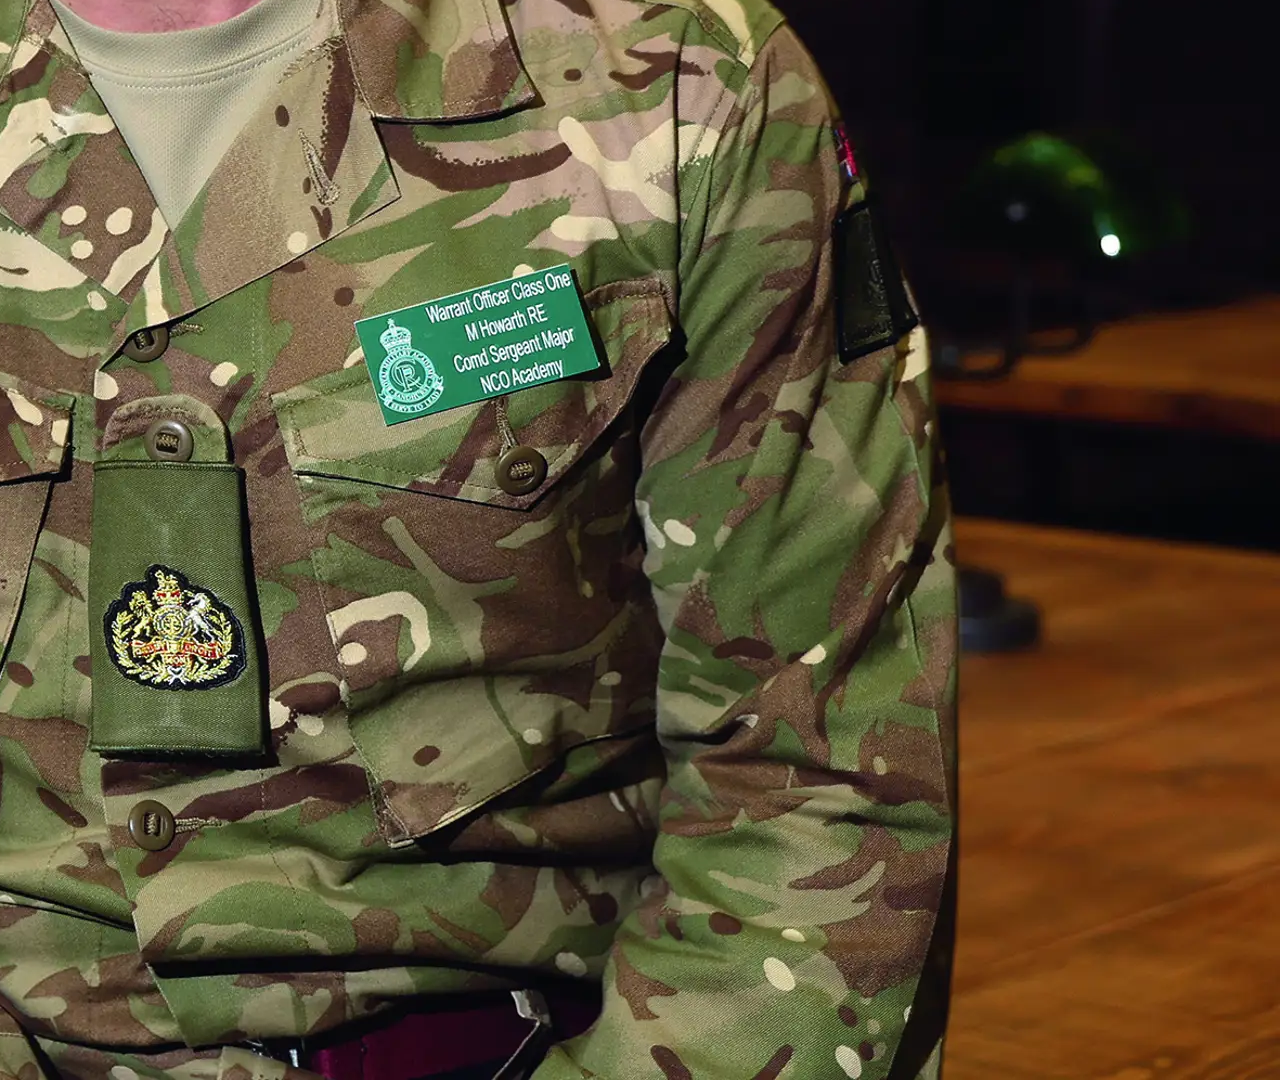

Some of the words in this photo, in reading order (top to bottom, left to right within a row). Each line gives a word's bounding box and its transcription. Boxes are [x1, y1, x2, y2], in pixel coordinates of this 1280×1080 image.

[425, 296, 473, 324] Warrant
[473, 289, 510, 311] Officer
[511, 280, 545, 300] Class
[544, 272, 571, 291] One
[464, 322, 479, 342] M
[478, 310, 528, 338] Howarth
[526, 303, 548, 324] RE
[453, 348, 489, 373] Comd
[489, 334, 543, 363] Sergeant
[541, 327, 574, 350] Major
[480, 370, 511, 394] NCO
[511, 360, 564, 387] Academy
